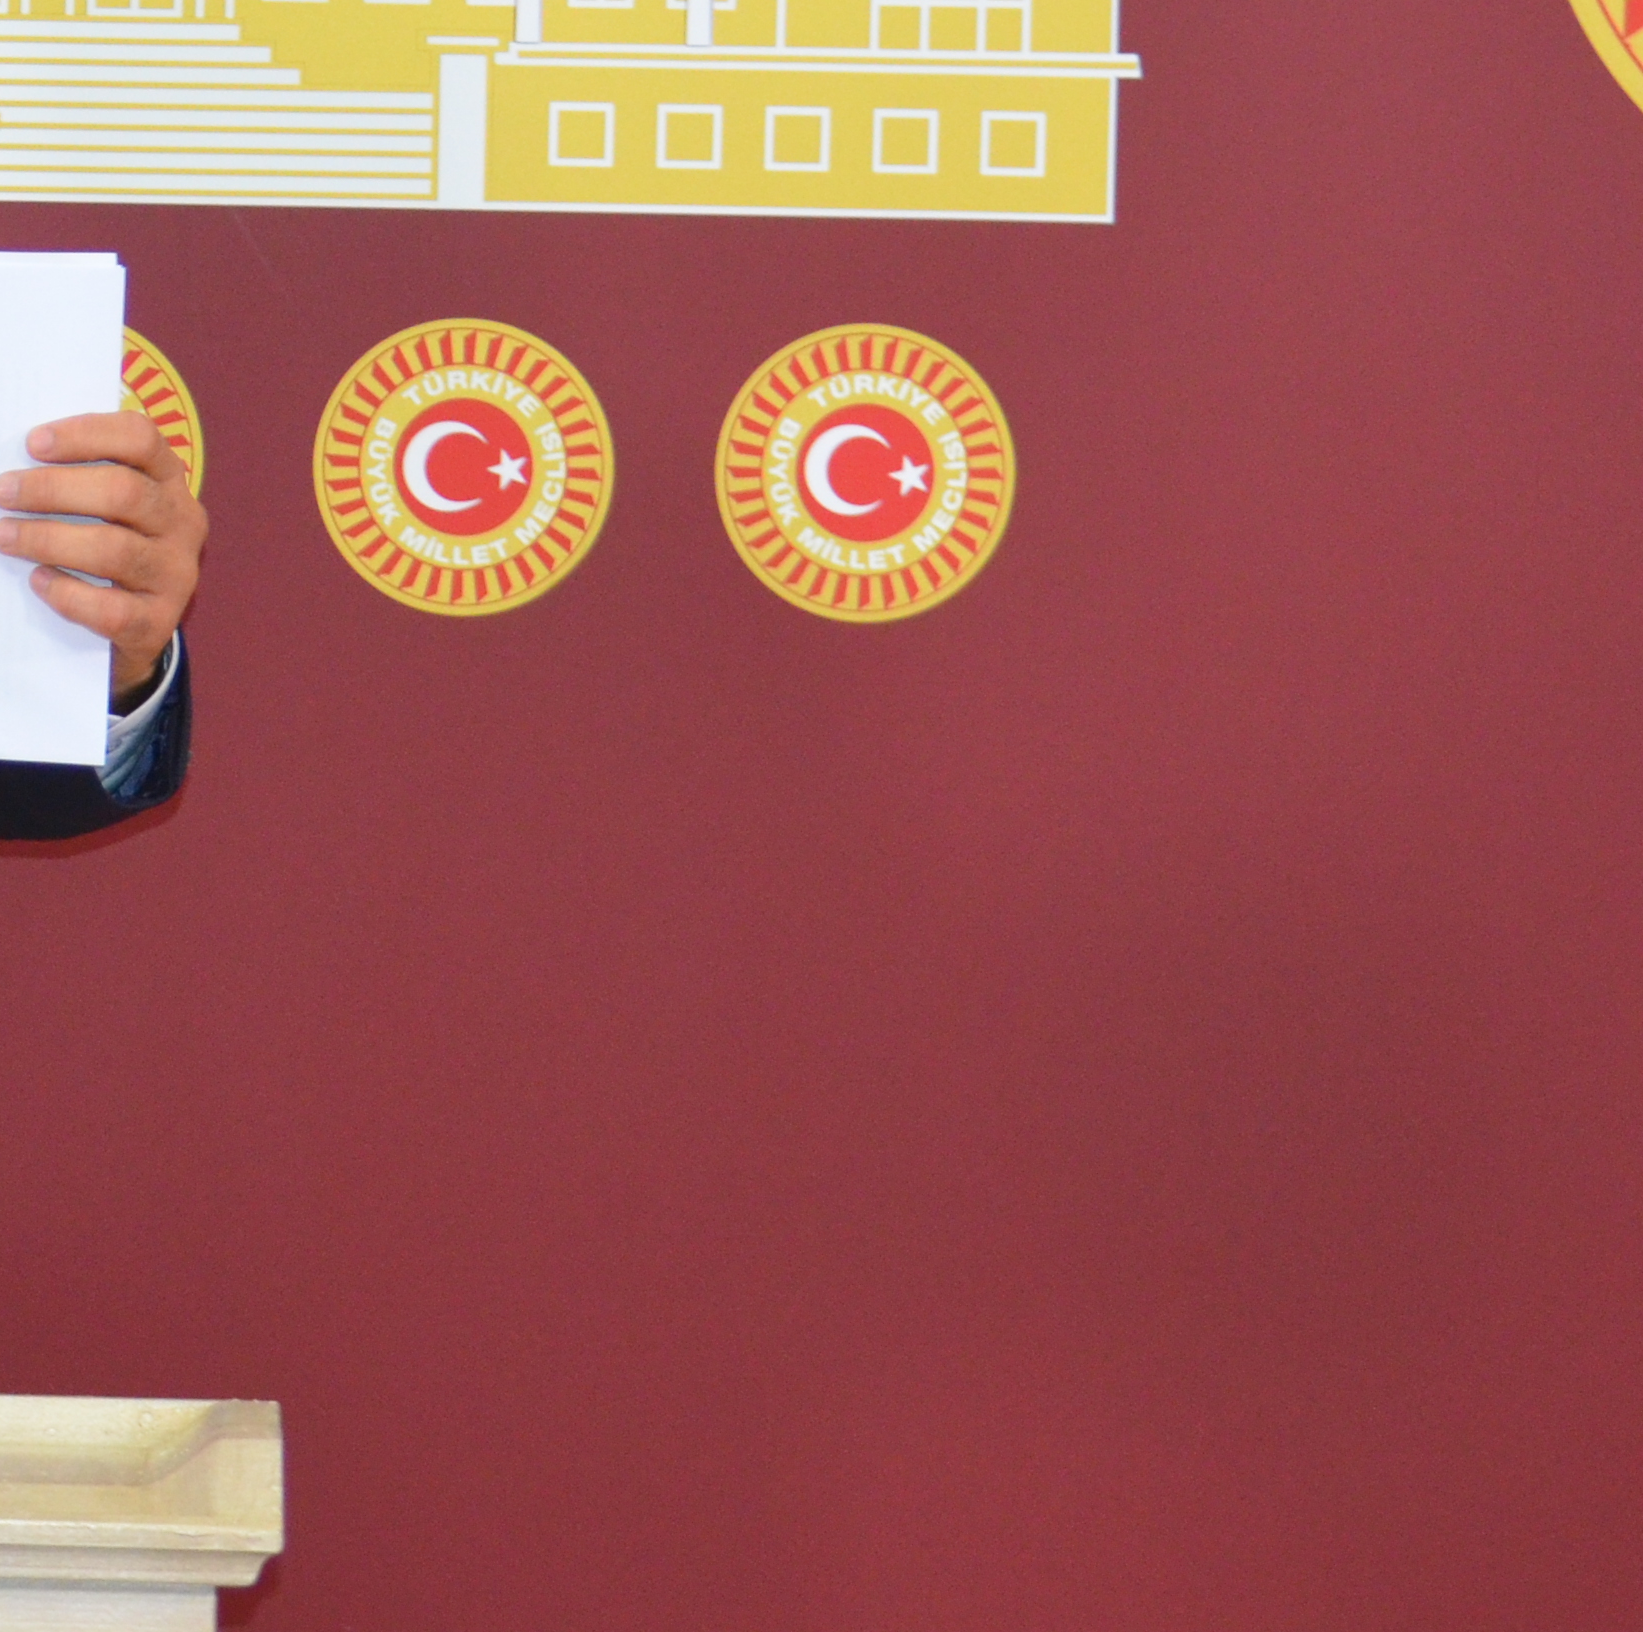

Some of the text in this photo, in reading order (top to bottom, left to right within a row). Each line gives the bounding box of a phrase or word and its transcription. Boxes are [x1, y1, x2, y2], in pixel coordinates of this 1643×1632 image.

[400, 369, 542, 418] TÜRKİYE
[807, 373, 947, 426] TÜRKİYE
[366, 416, 402, 526] BÜYÜK
[398, 525, 508, 566] MİLLET
[768, 416, 803, 525] BÜYÜK
[795, 526, 906, 570] MİLLET
